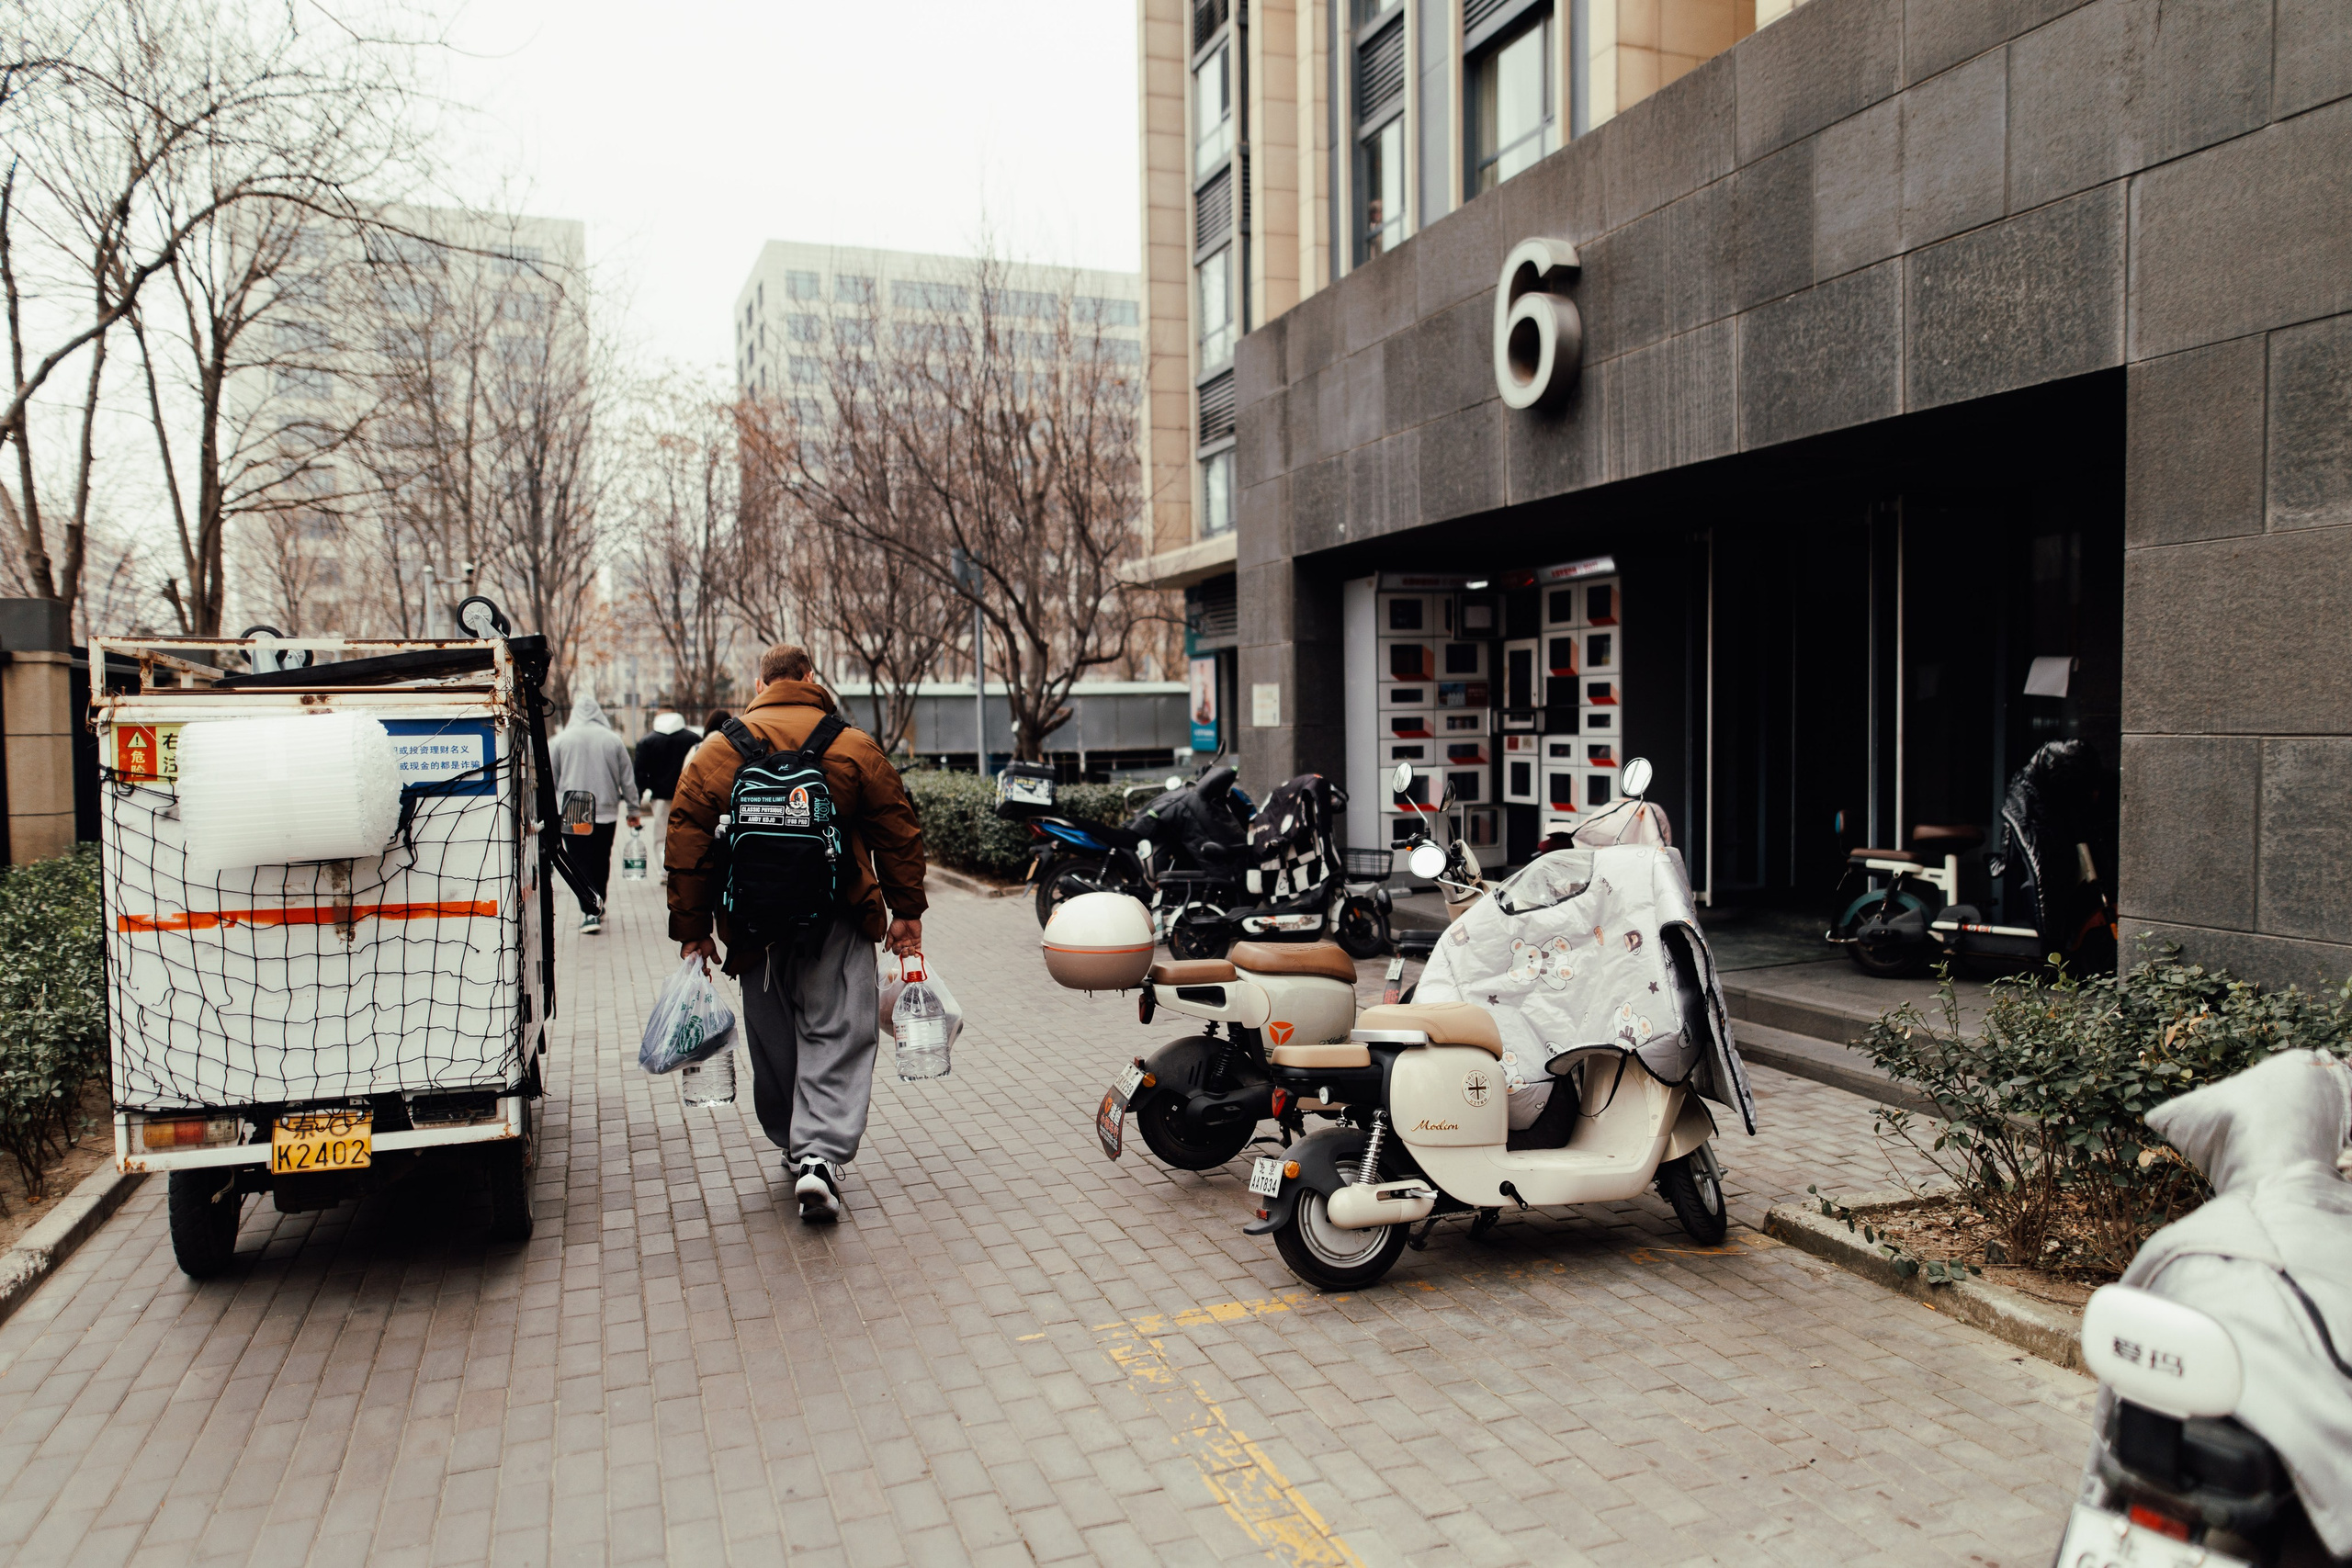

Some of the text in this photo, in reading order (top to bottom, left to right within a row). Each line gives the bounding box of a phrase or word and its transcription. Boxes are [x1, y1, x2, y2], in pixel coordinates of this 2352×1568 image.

[1492, 237, 1578, 410] 6
[393, 745, 469, 755] 或投资理财名义
[819, 797, 831, 822] 101
[1410, 1118, 1459, 1133] Modern
[277, 1140, 365, 1170] K2402
[1250, 1175, 1277, 1193] AAT834
